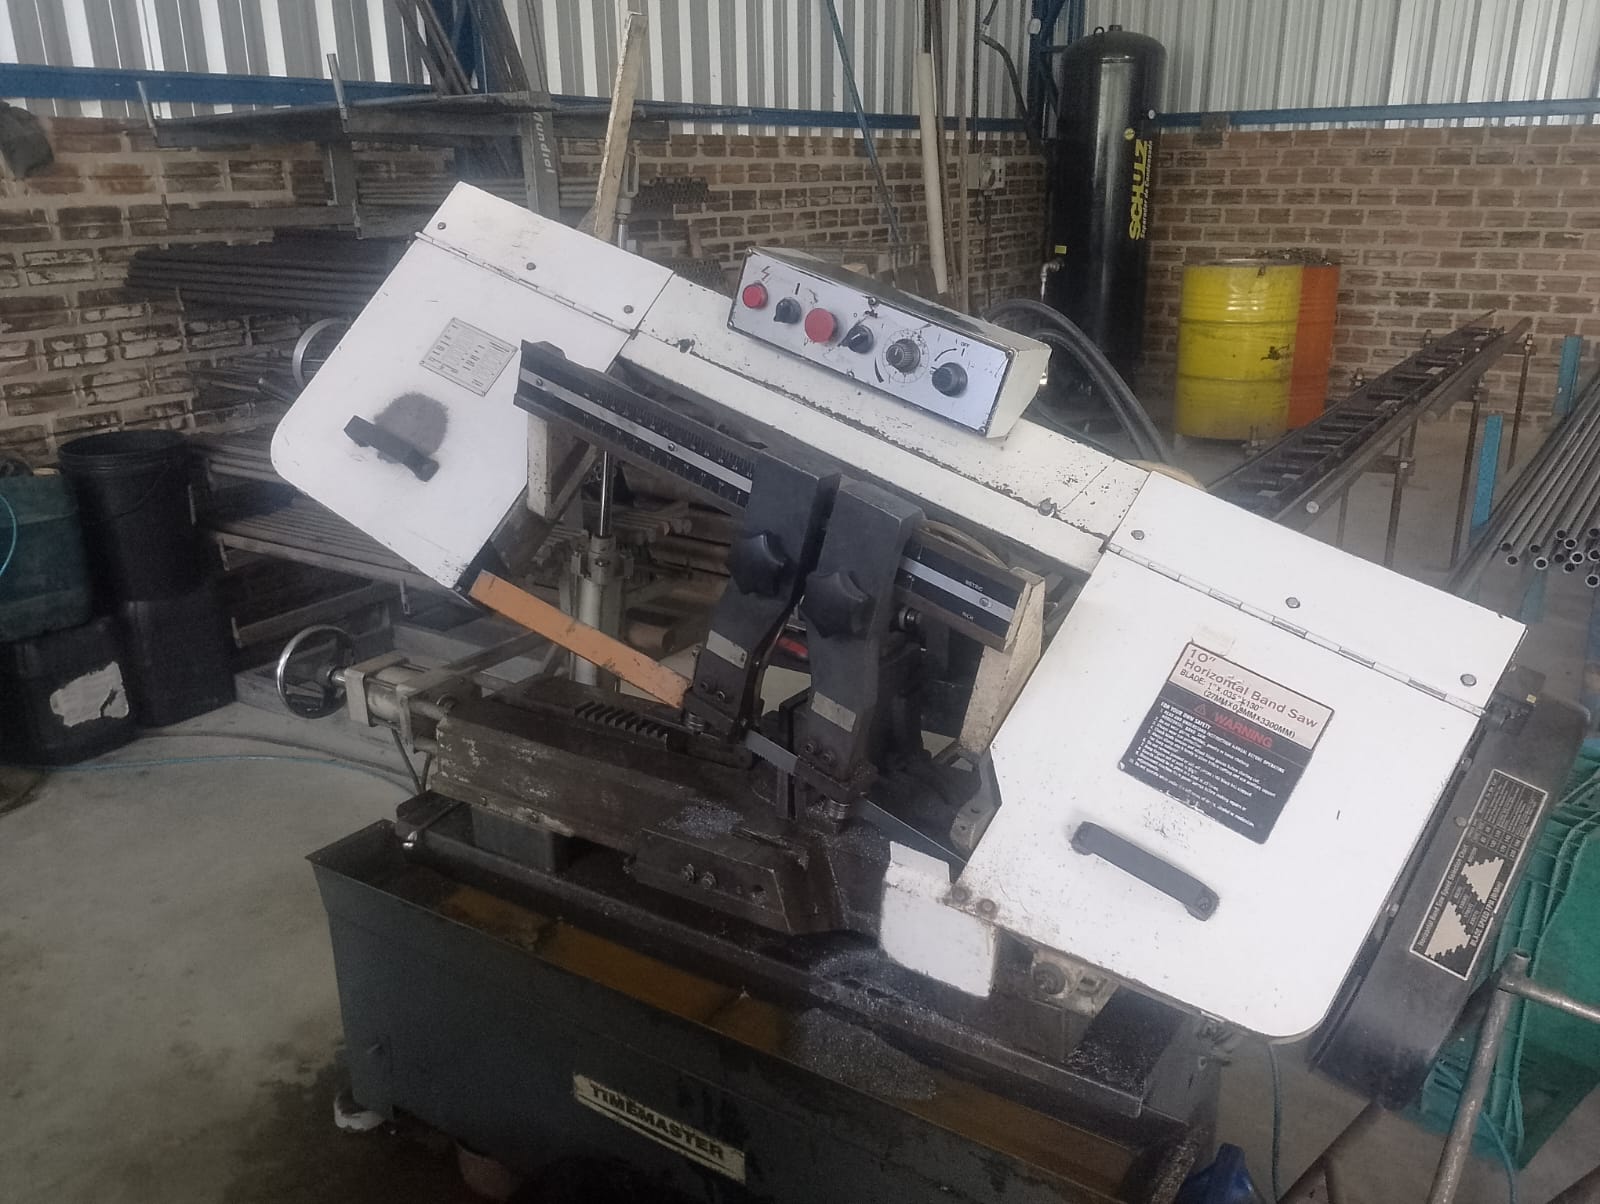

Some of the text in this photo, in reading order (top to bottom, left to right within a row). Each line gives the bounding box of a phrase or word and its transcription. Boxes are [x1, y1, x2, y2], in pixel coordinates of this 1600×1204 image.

[1129, 138, 1148, 240] SCHULZ
[1179, 668, 1206, 685] BLADE:
[1183, 657, 1318, 729] Horizontal Band Saw
[1213, 711, 1274, 748] WARNING
[590, 1079, 724, 1160] TIMEMASTER
